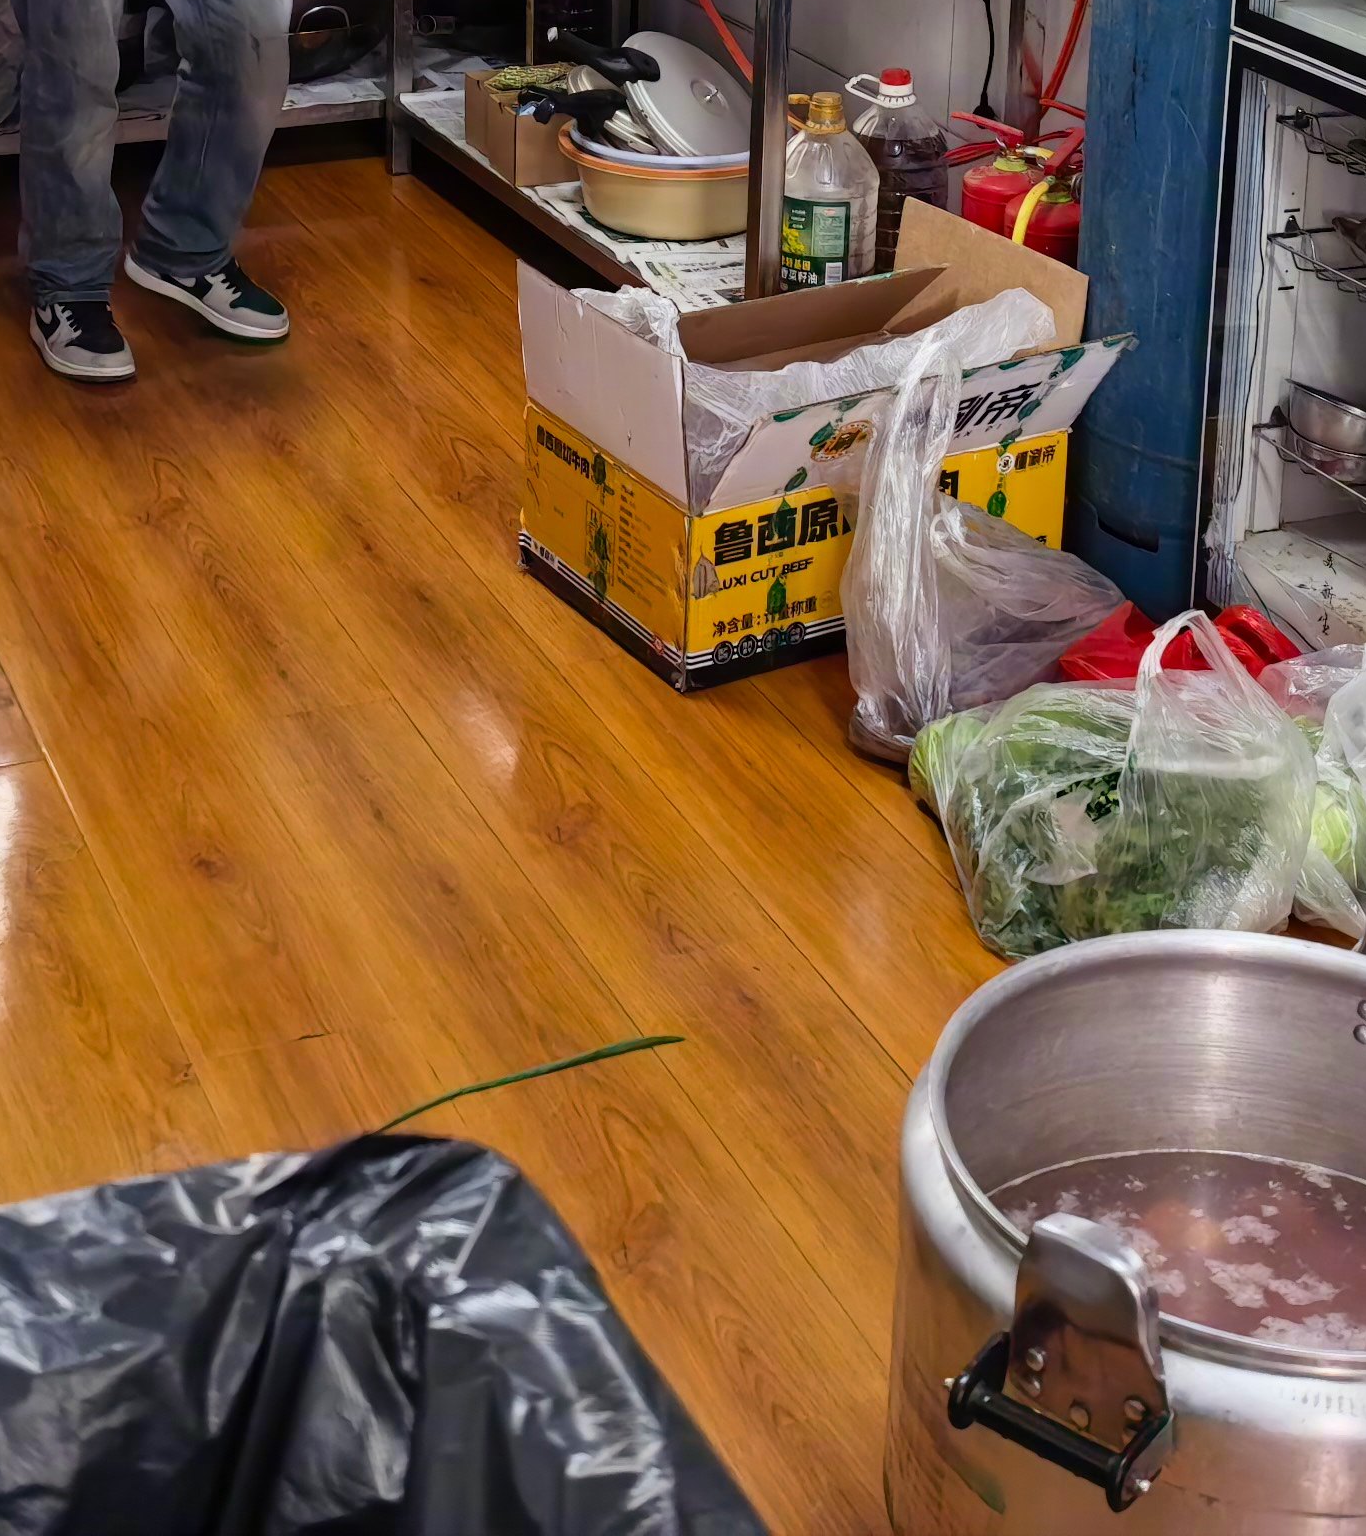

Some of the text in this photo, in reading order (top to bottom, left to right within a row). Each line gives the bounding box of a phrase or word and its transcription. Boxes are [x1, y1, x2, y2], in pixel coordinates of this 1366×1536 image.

[719, 557, 815, 591] UXI CUT BEEF
